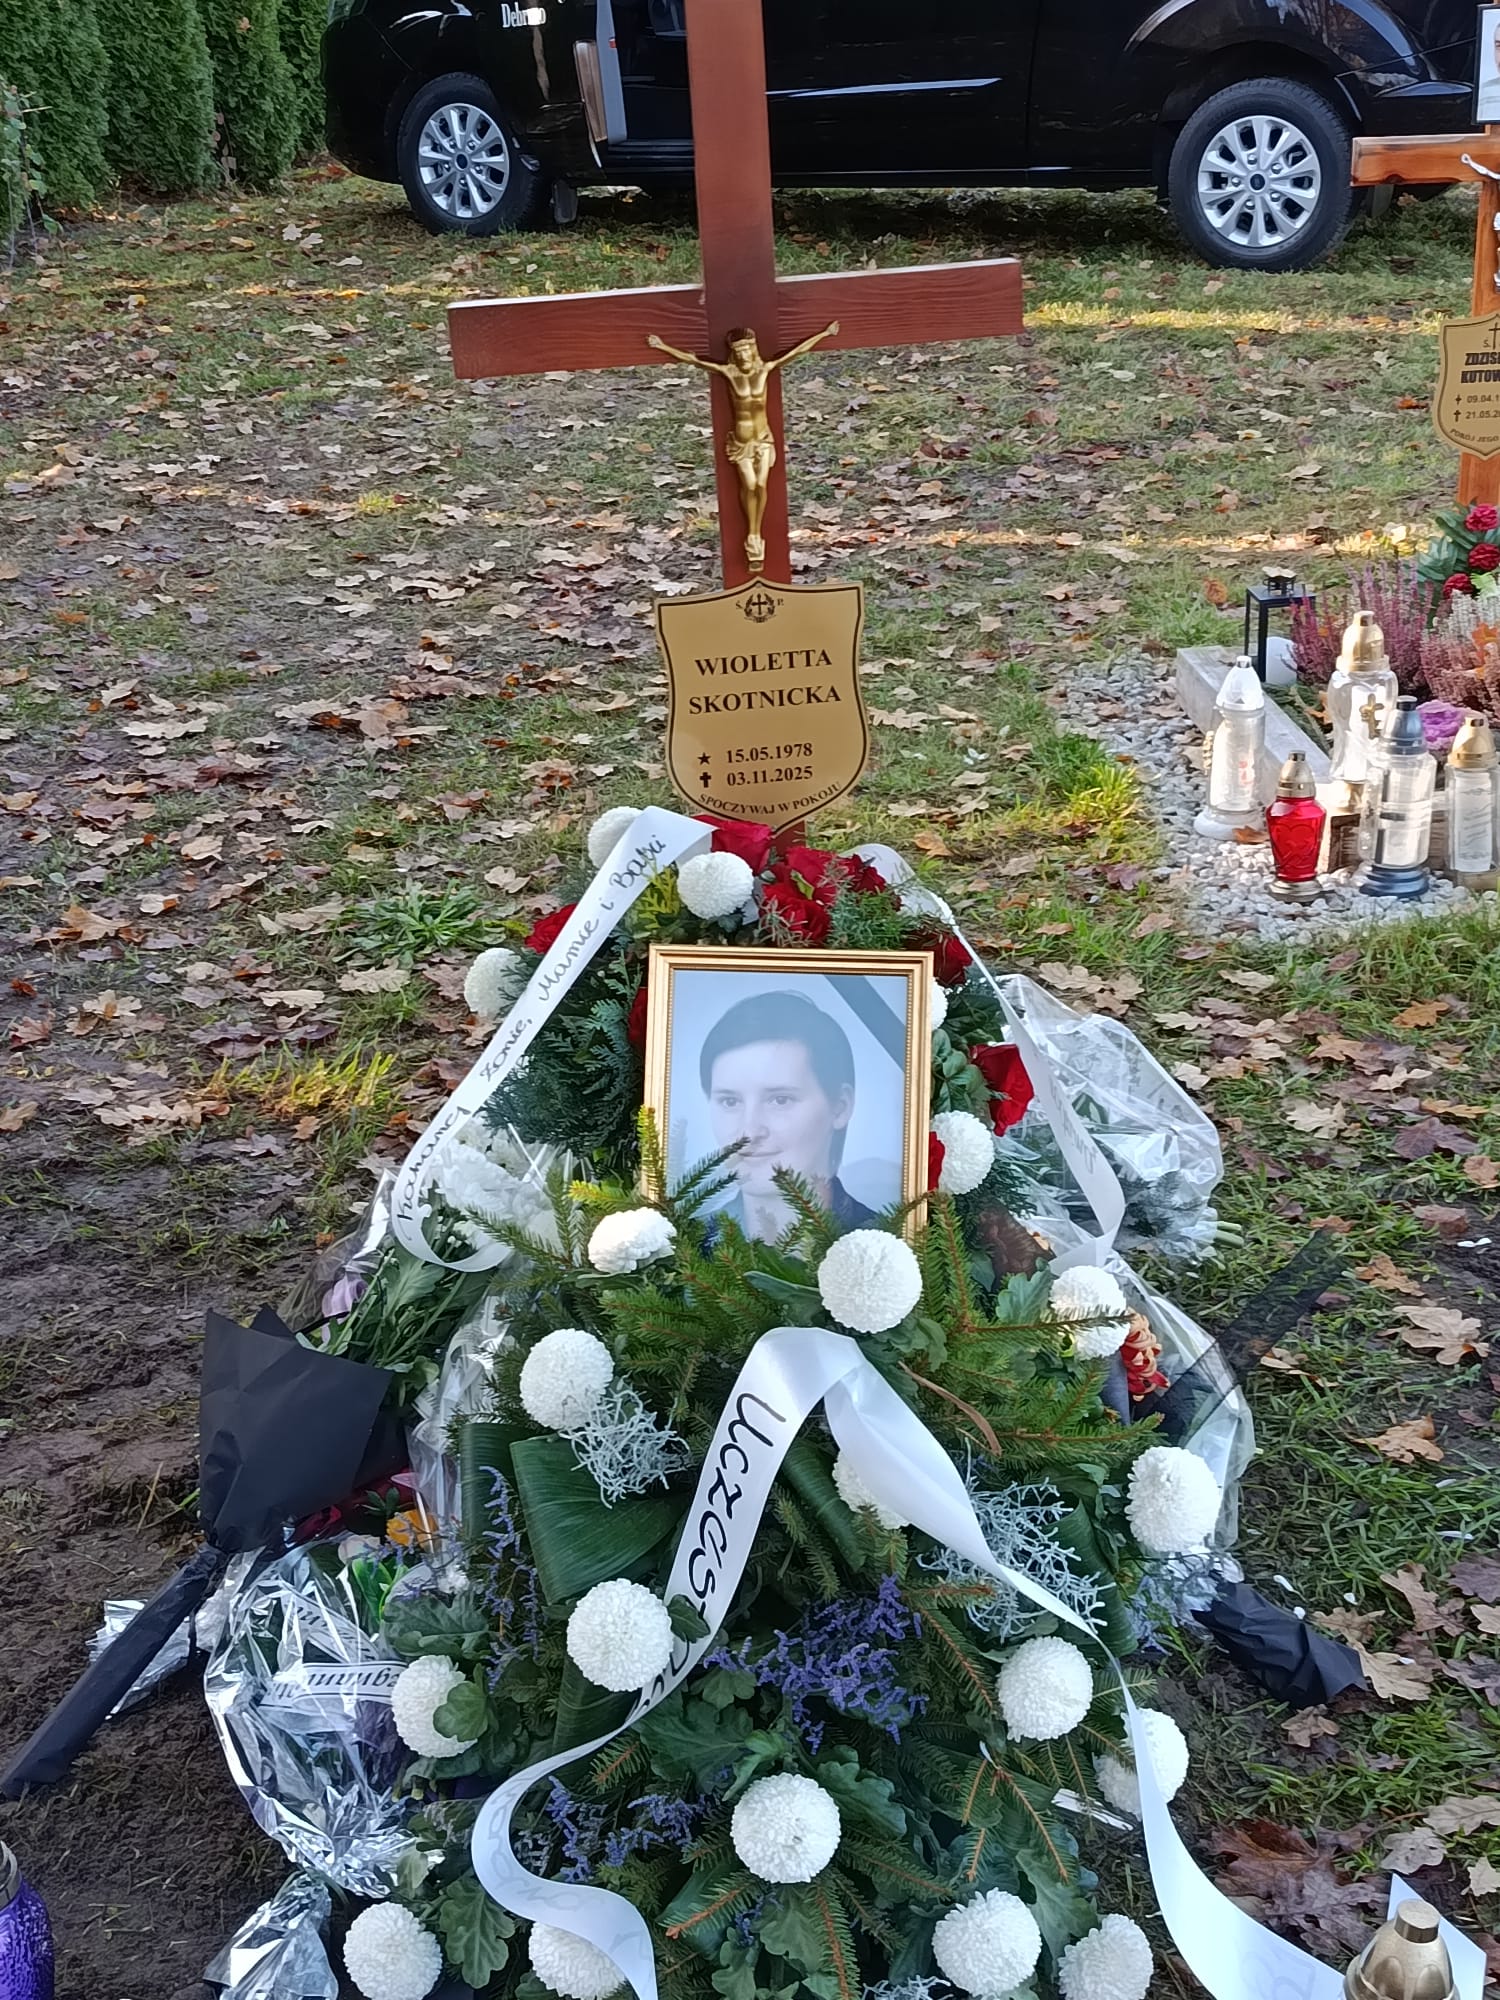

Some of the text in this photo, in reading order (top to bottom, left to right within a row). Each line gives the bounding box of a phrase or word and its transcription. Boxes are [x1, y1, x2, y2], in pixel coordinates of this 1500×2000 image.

[501, 1, 547, 28] Debro
[1465, 352, 1500, 366] ZDZIS
[695, 648, 833, 677] WIOLETTA
[688, 685, 842, 715] SKOTNICKA
[726, 742, 814, 764] 15.05.1978
[726, 765, 814, 787] 03.11.2025
[698, 781, 841, 815] SPOCZYWAJ W POKOJU
